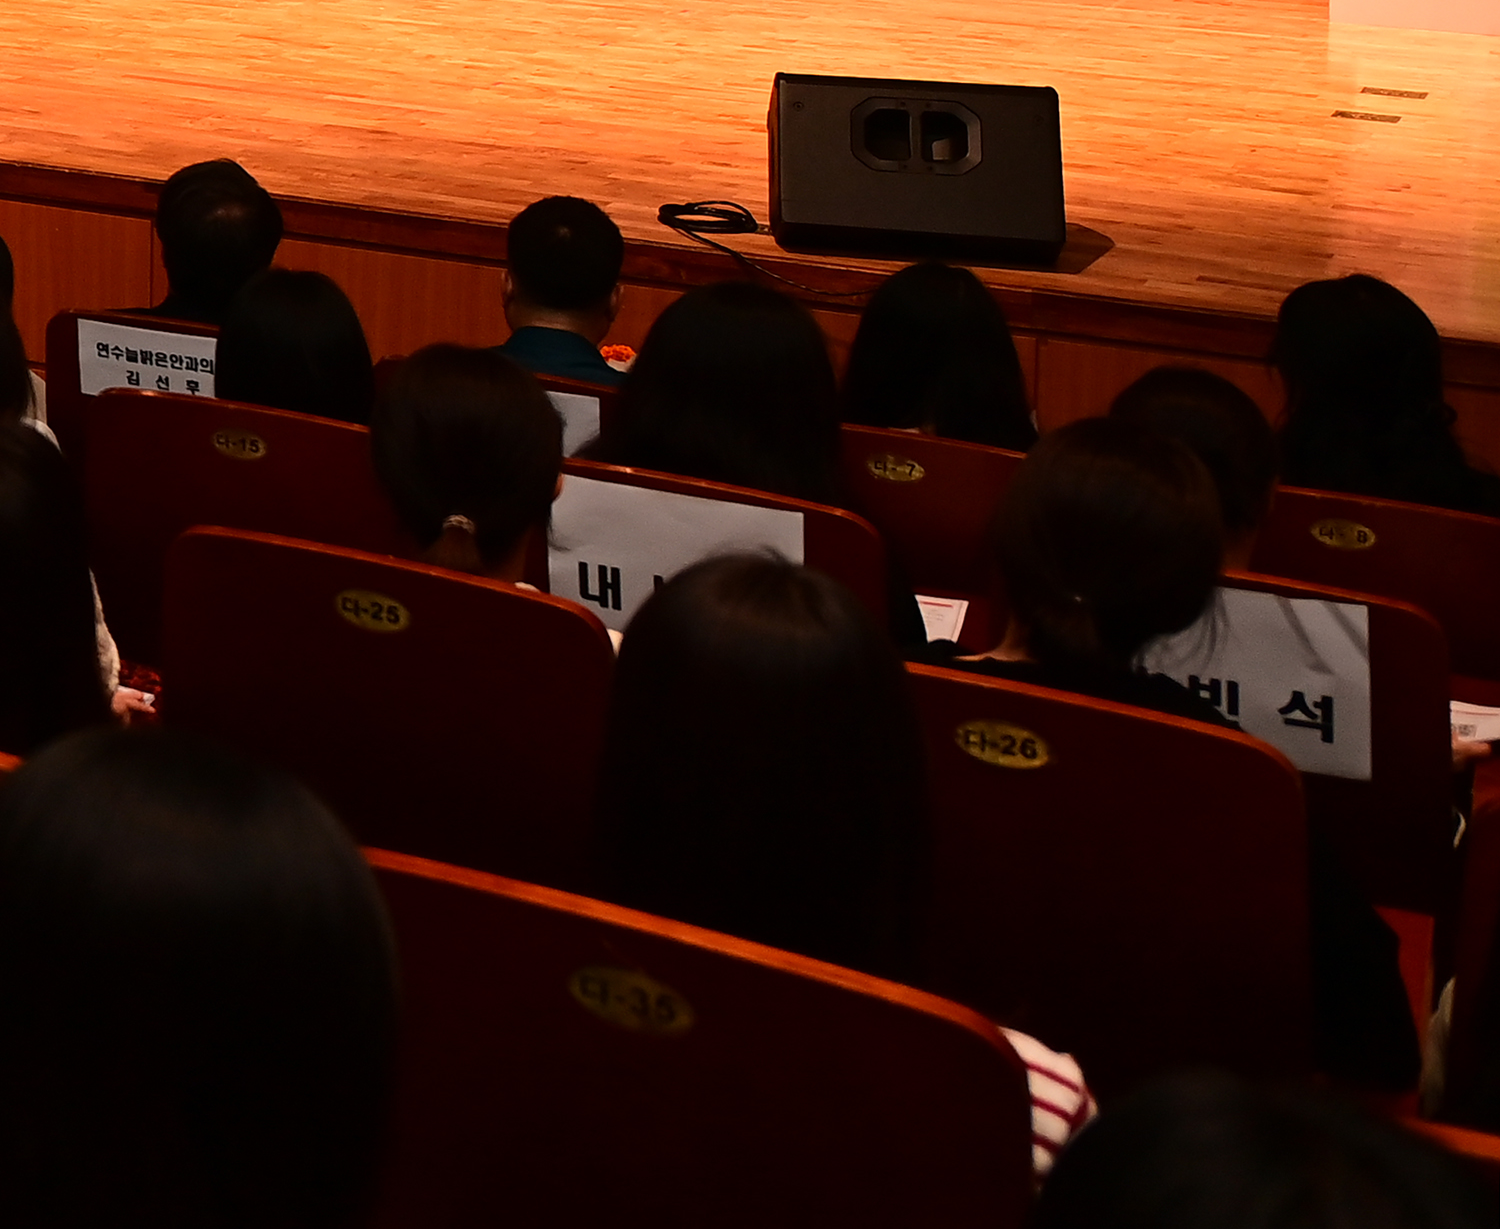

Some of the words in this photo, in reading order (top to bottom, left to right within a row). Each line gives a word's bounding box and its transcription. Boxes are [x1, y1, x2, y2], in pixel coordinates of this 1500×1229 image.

[341, 596, 400, 624] 다-25
[1278, 690, 1334, 744] 석
[964, 729, 1038, 760] 다-26
